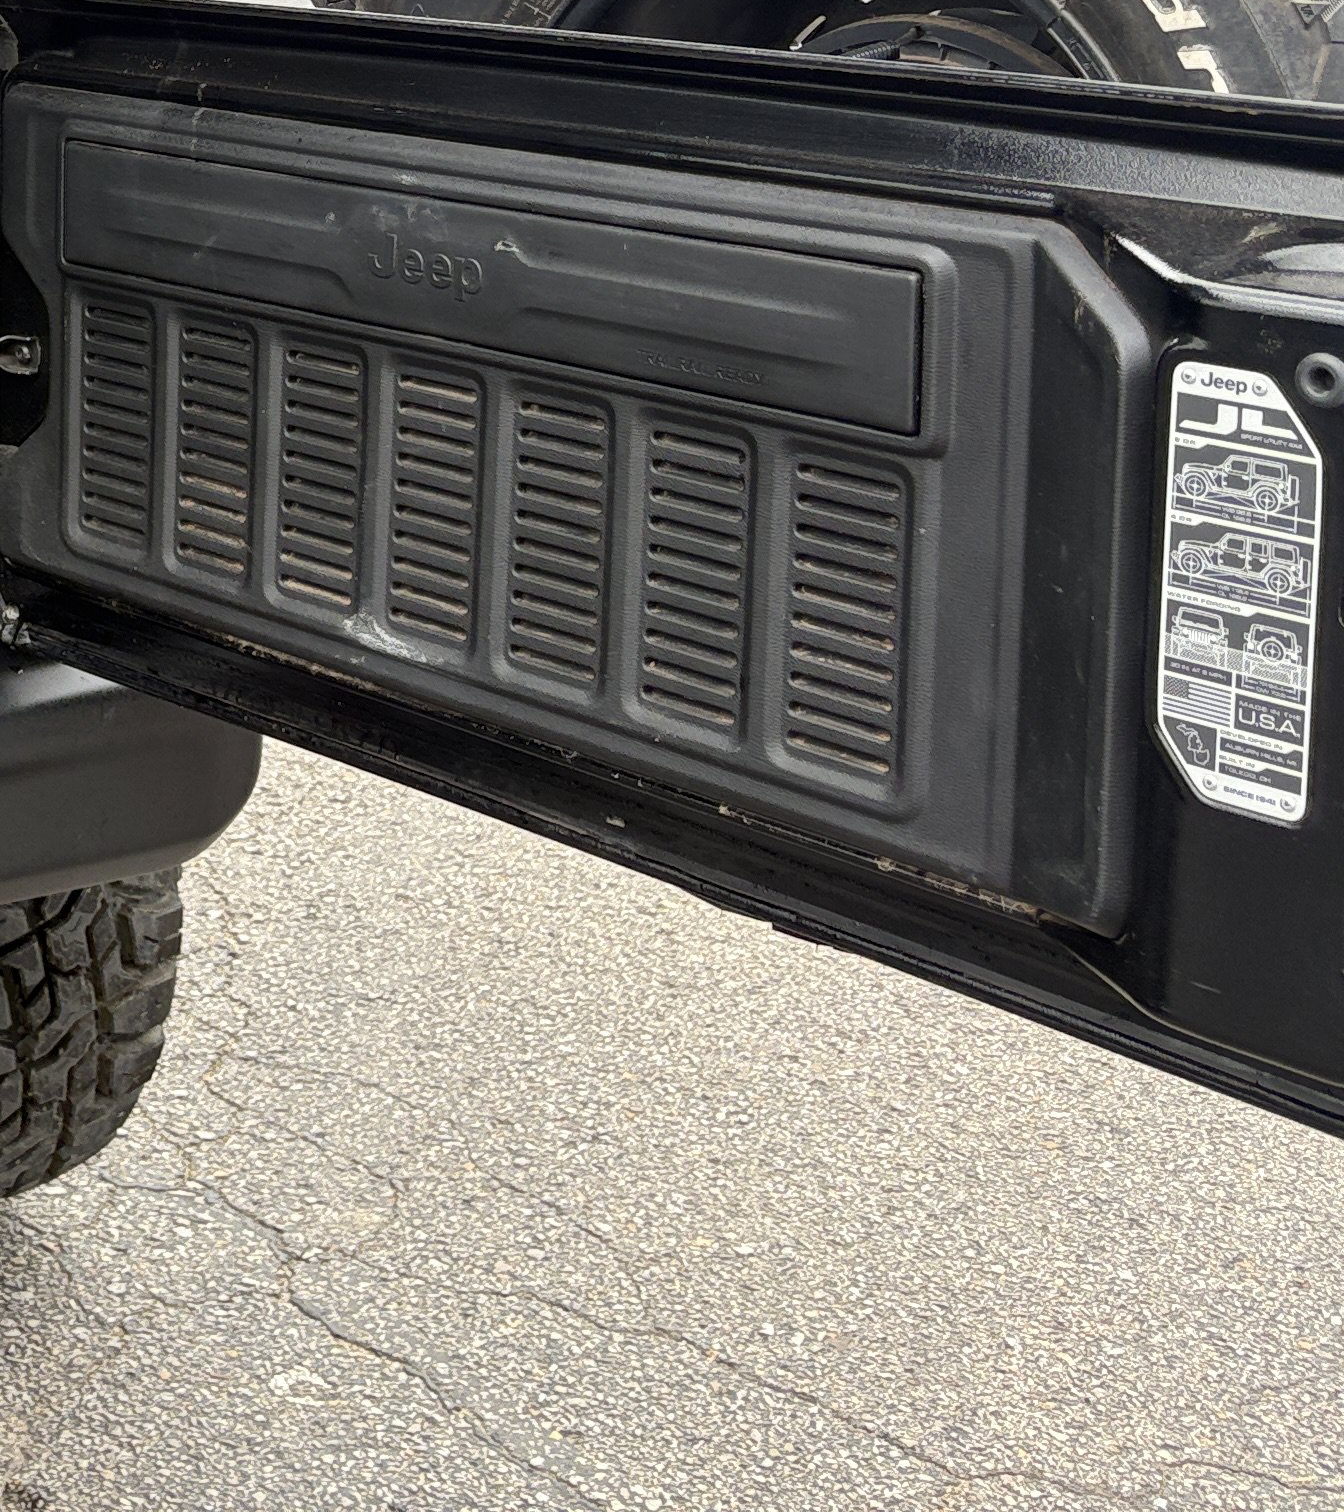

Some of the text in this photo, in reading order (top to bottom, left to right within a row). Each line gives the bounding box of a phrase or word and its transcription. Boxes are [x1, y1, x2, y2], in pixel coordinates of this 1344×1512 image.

[367, 232, 483, 303] Jeep
[1200, 372, 1248, 395] Jeep
[1179, 403, 1299, 441] JL
[1167, 590, 1199, 603] WATER
[1238, 700, 1268, 713] MADE
[1223, 786, 1254, 800] SINCE
